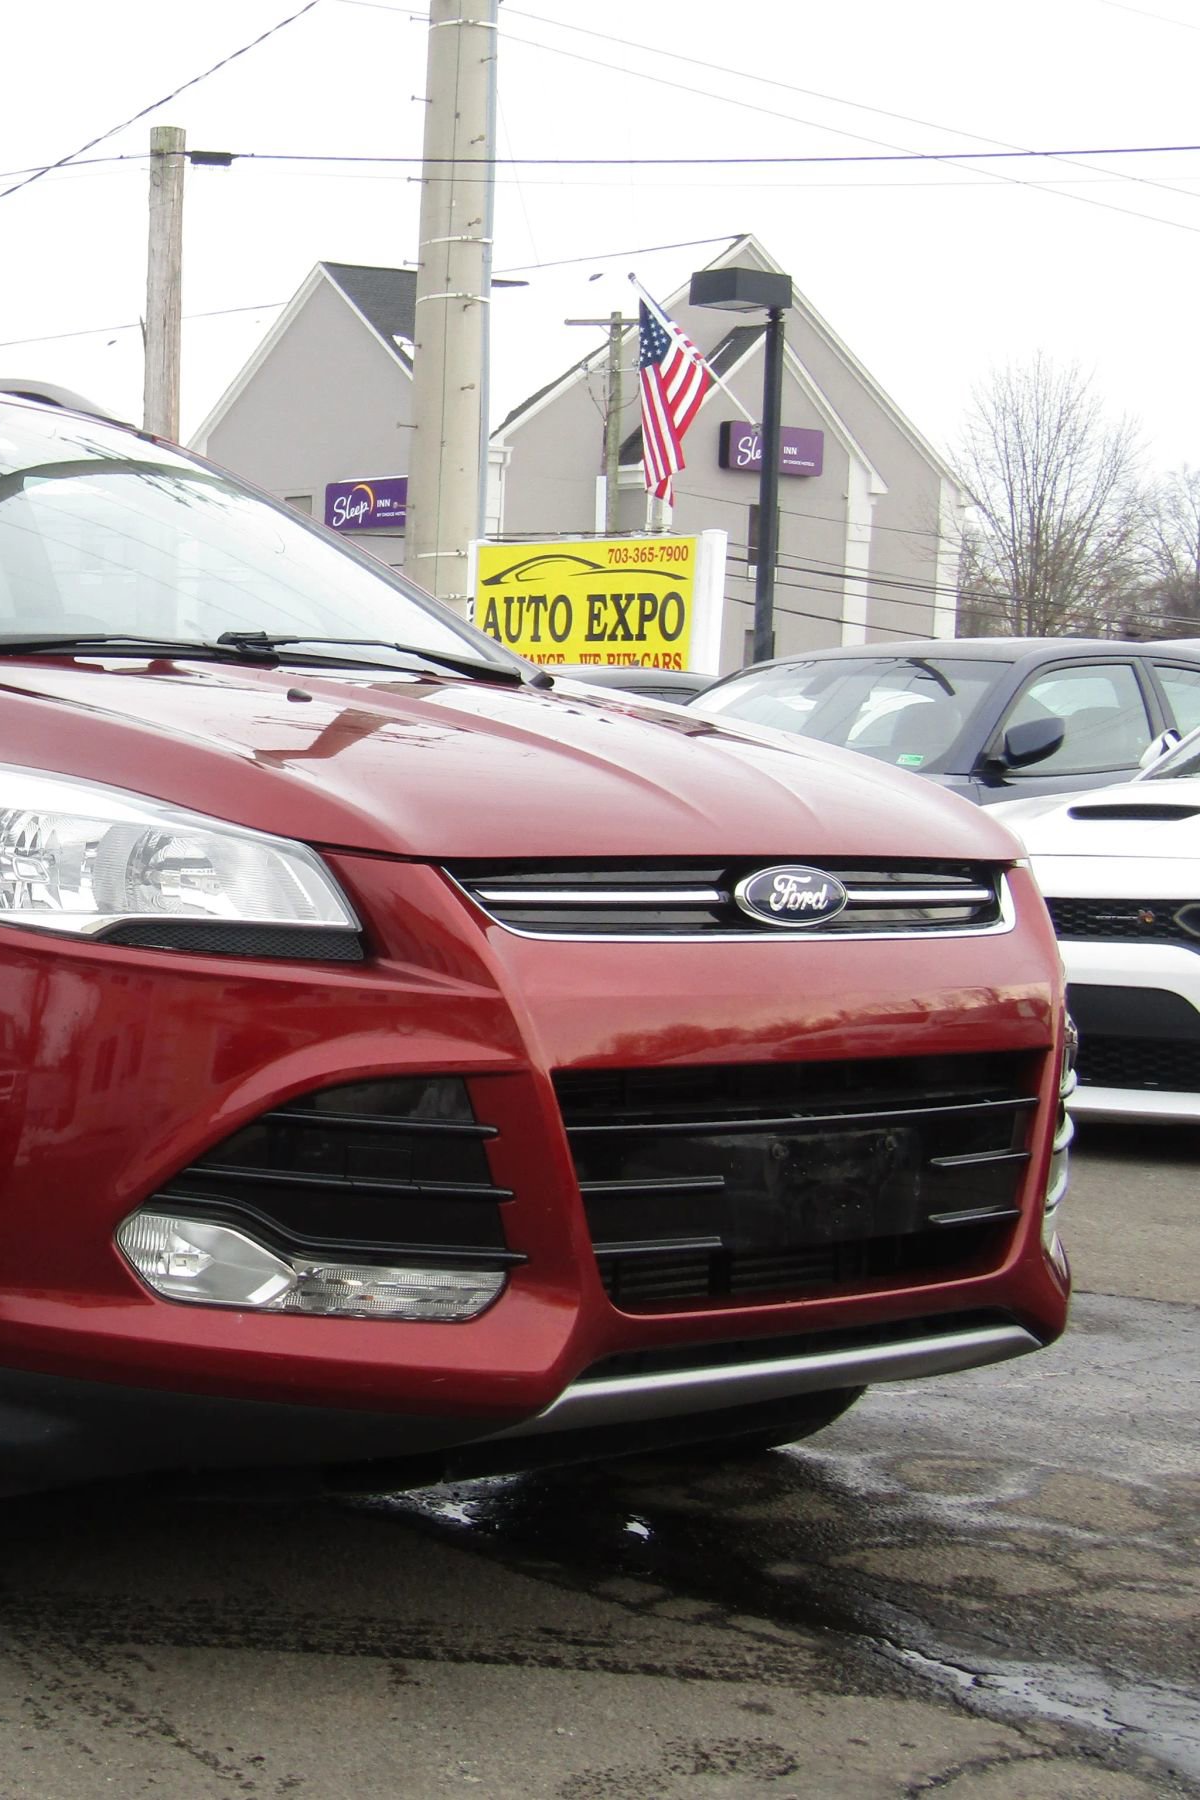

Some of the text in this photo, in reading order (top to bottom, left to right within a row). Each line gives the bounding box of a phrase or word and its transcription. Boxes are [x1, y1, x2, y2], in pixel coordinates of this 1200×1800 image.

[737, 436, 798, 465] Sle INN
[332, 495, 391, 526] Sleep INN
[607, 545, 689, 564] 703-365-7900
[482, 594, 573, 644] AUTO
[584, 591, 685, 642] EXPO
[641, 652, 682, 671] CARS
[769, 874, 829, 912] Ford
